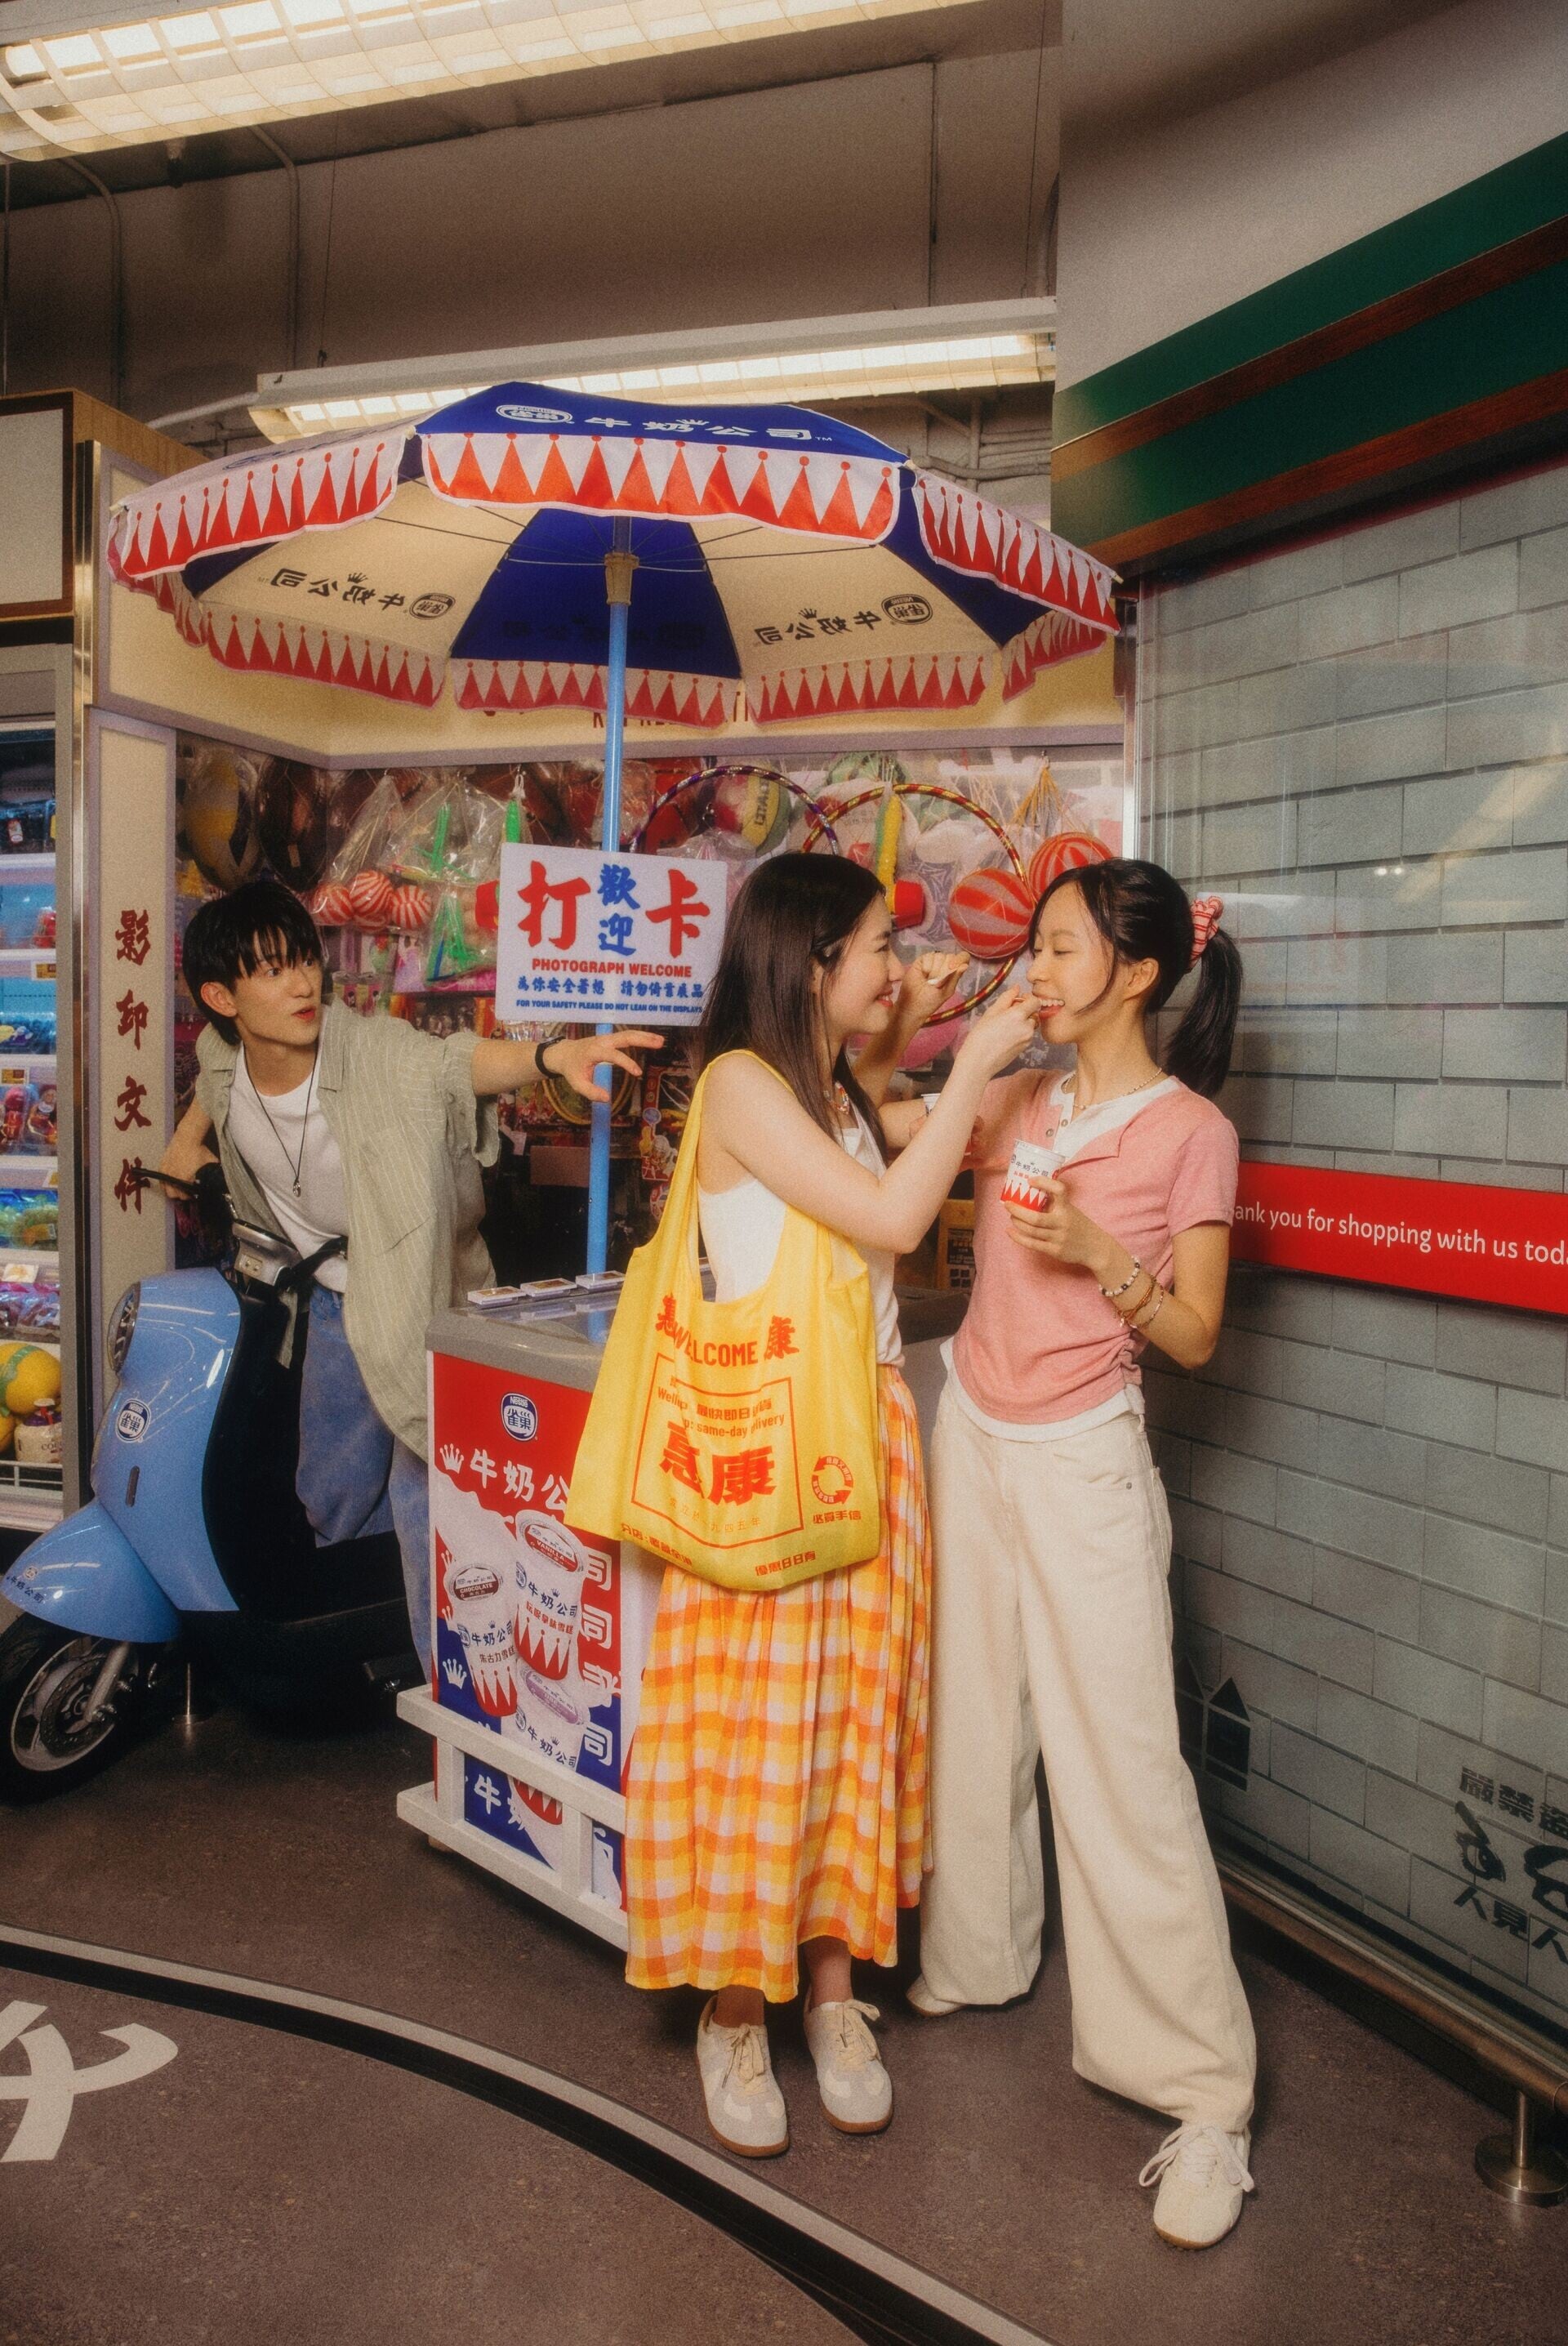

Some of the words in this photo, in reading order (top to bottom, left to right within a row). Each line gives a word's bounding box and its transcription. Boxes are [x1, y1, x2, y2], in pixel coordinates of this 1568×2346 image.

[584, 416, 812, 440] 牛奶公司
[517, 860, 591, 951] 打
[645, 868, 710, 959] 卡
[597, 863, 641, 957] 歡迎
[532, 958, 625, 975] PHOTOGRAPH
[629, 963, 692, 978] WELCOME
[532, 1001, 550, 1009] YOUR
[552, 1001, 577, 1010] SAFETY
[579, 1002, 603, 1010] PLEASE
[615, 1003, 628, 1011] NOT
[673, 1006, 702, 1014] DISPLAYS
[114, 909, 152, 1215] 影印文件
[1234, 1201, 1266, 1224] ank
[1269, 1210, 1302, 1230] you
[1306, 1207, 1334, 1233] for
[1339, 1213, 1432, 1253] shopping
[1437, 1229, 1486, 1255] with
[1493, 1240, 1518, 1259] us
[1524, 1239, 1568, 1265] tod
[506, 1407, 532, 1431] 雀巢
[697, 1423, 748, 1439] same-day
[470, 1447, 571, 1514] 牛奶公
[536, 1539, 565, 1561] VANILLA
[459, 1582, 494, 1594] CHOCOLATE
[528, 1581, 578, 1618] 牛奶公司
[471, 1619, 514, 1647] 牛奶公司
[527, 1724, 577, 1768] 牛奶公司
